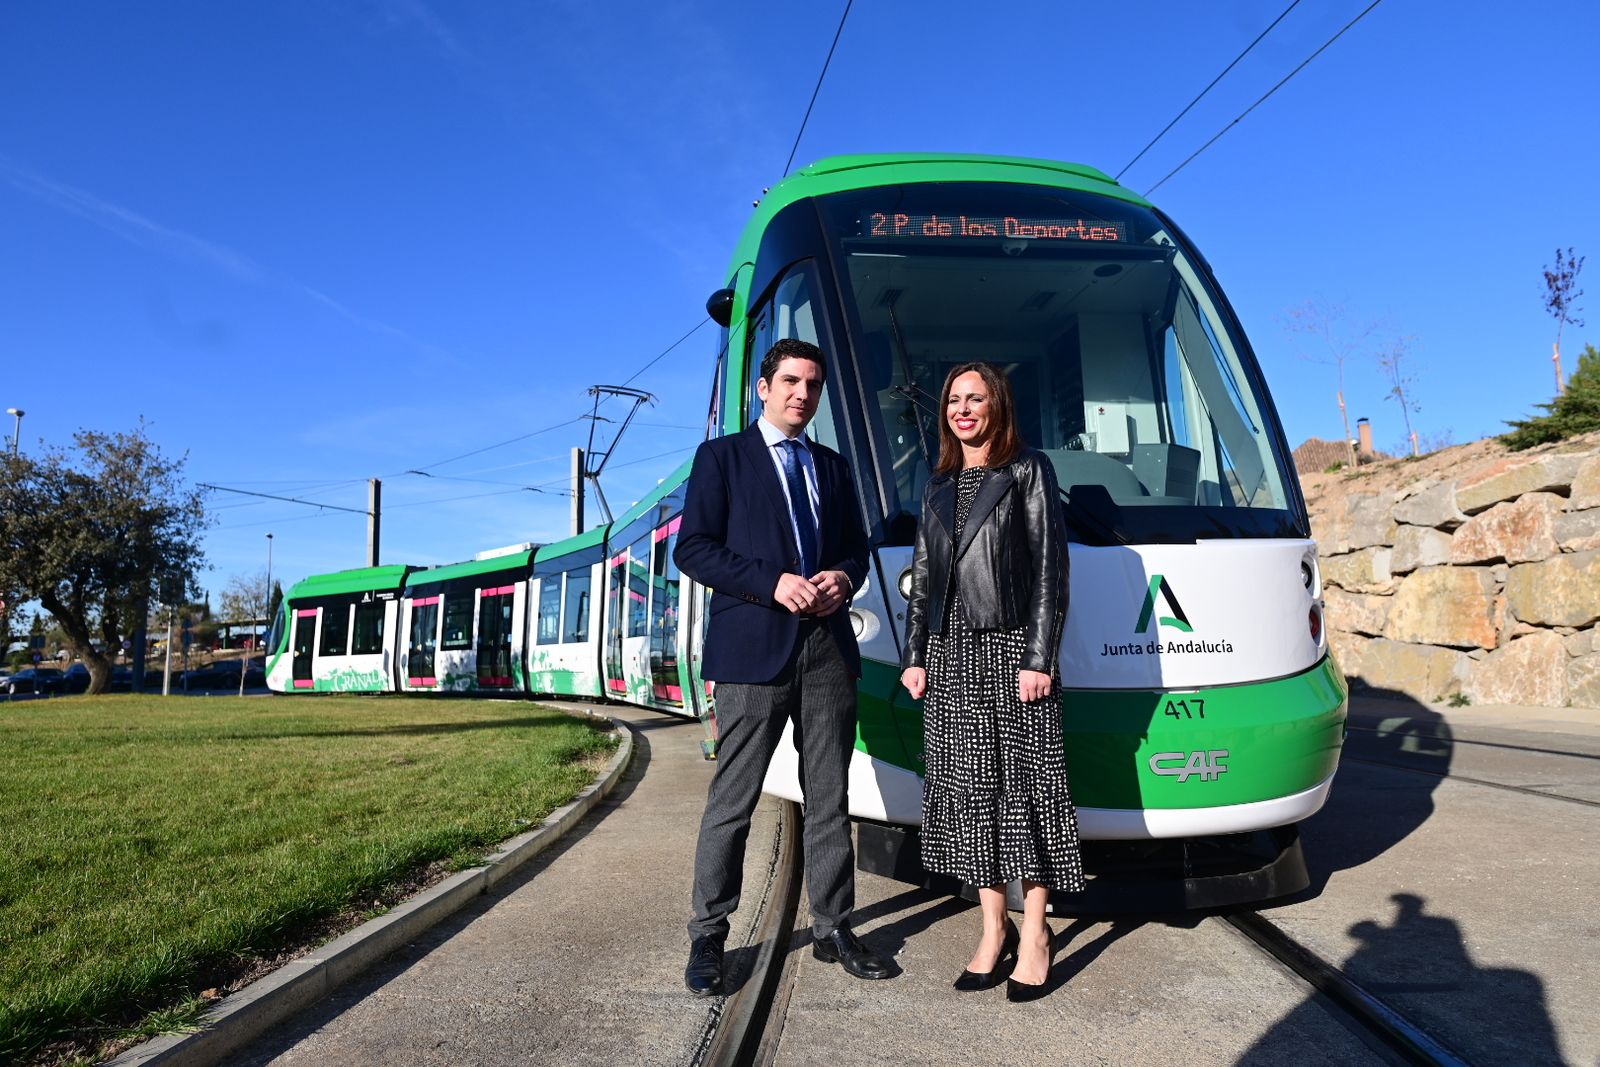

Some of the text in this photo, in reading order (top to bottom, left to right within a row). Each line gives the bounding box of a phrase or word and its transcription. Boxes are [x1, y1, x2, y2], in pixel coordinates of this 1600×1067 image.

[871, 212, 1118, 241] 2 P. de los Deportes
[1101, 639, 1233, 656] Junta de Andalucía
[1164, 699, 1205, 719] 417
[1149, 749, 1229, 783] CAF
